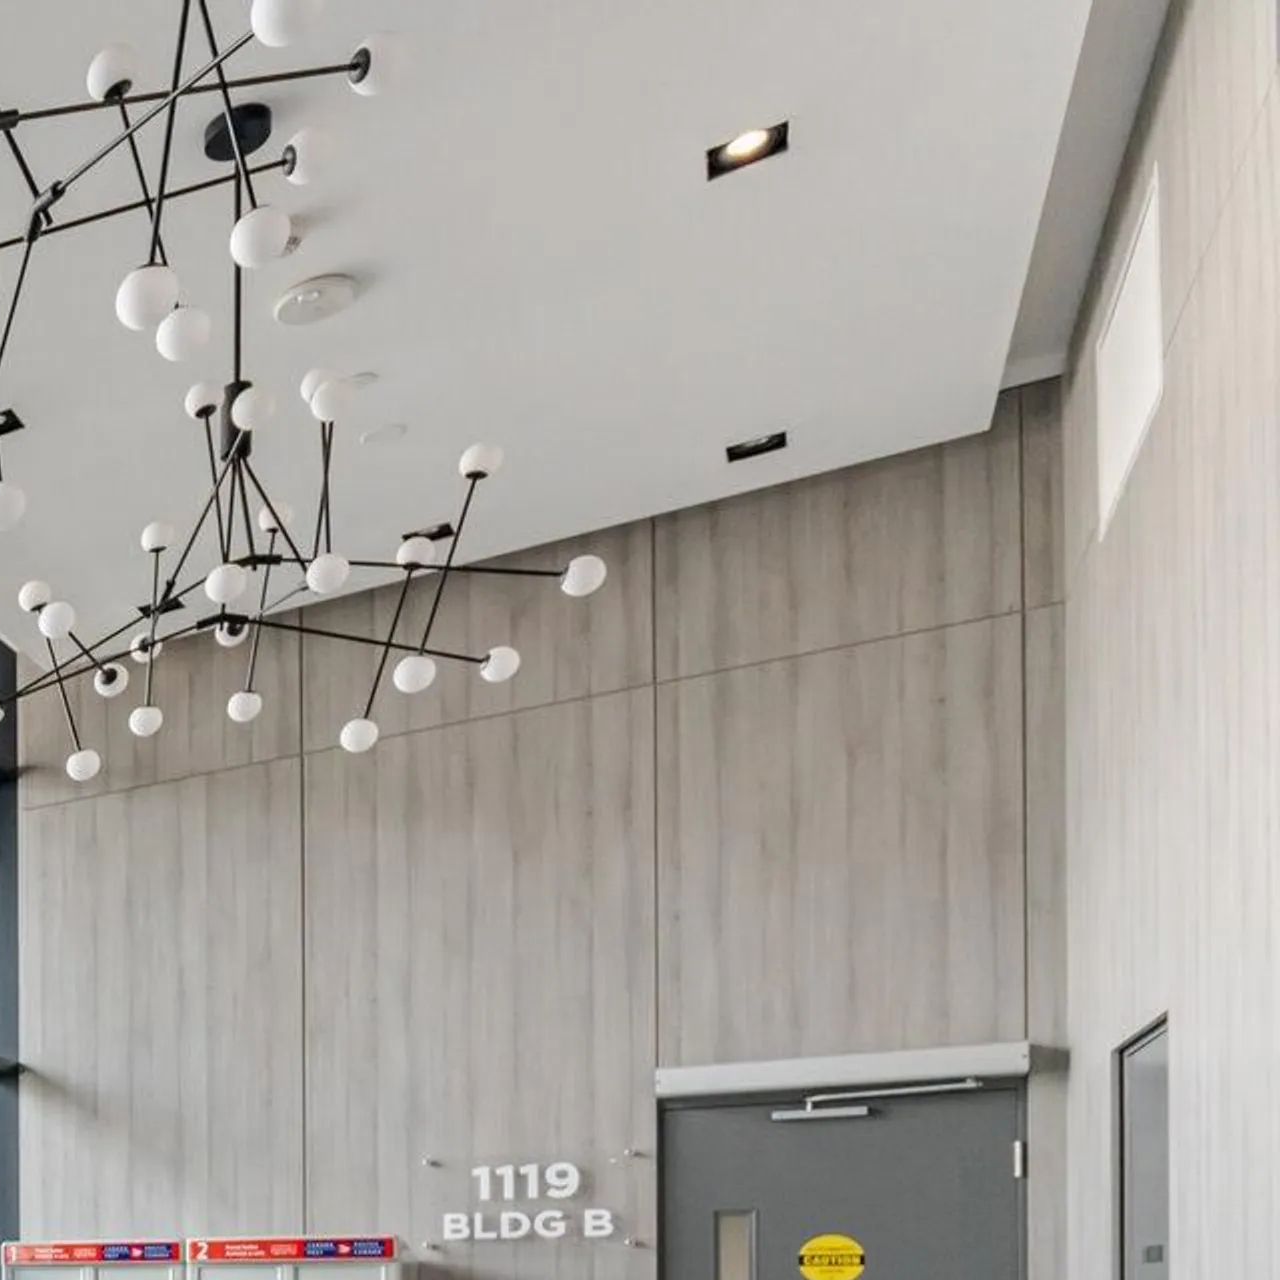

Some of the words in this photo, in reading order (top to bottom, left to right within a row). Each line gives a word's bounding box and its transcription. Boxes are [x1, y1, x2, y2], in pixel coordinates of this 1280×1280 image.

[471, 1162, 580, 1200] 1119
[443, 1210, 566, 1240] BLDG
[584, 1208, 614, 1238] B
[196, 1242, 208, 1260] 2
